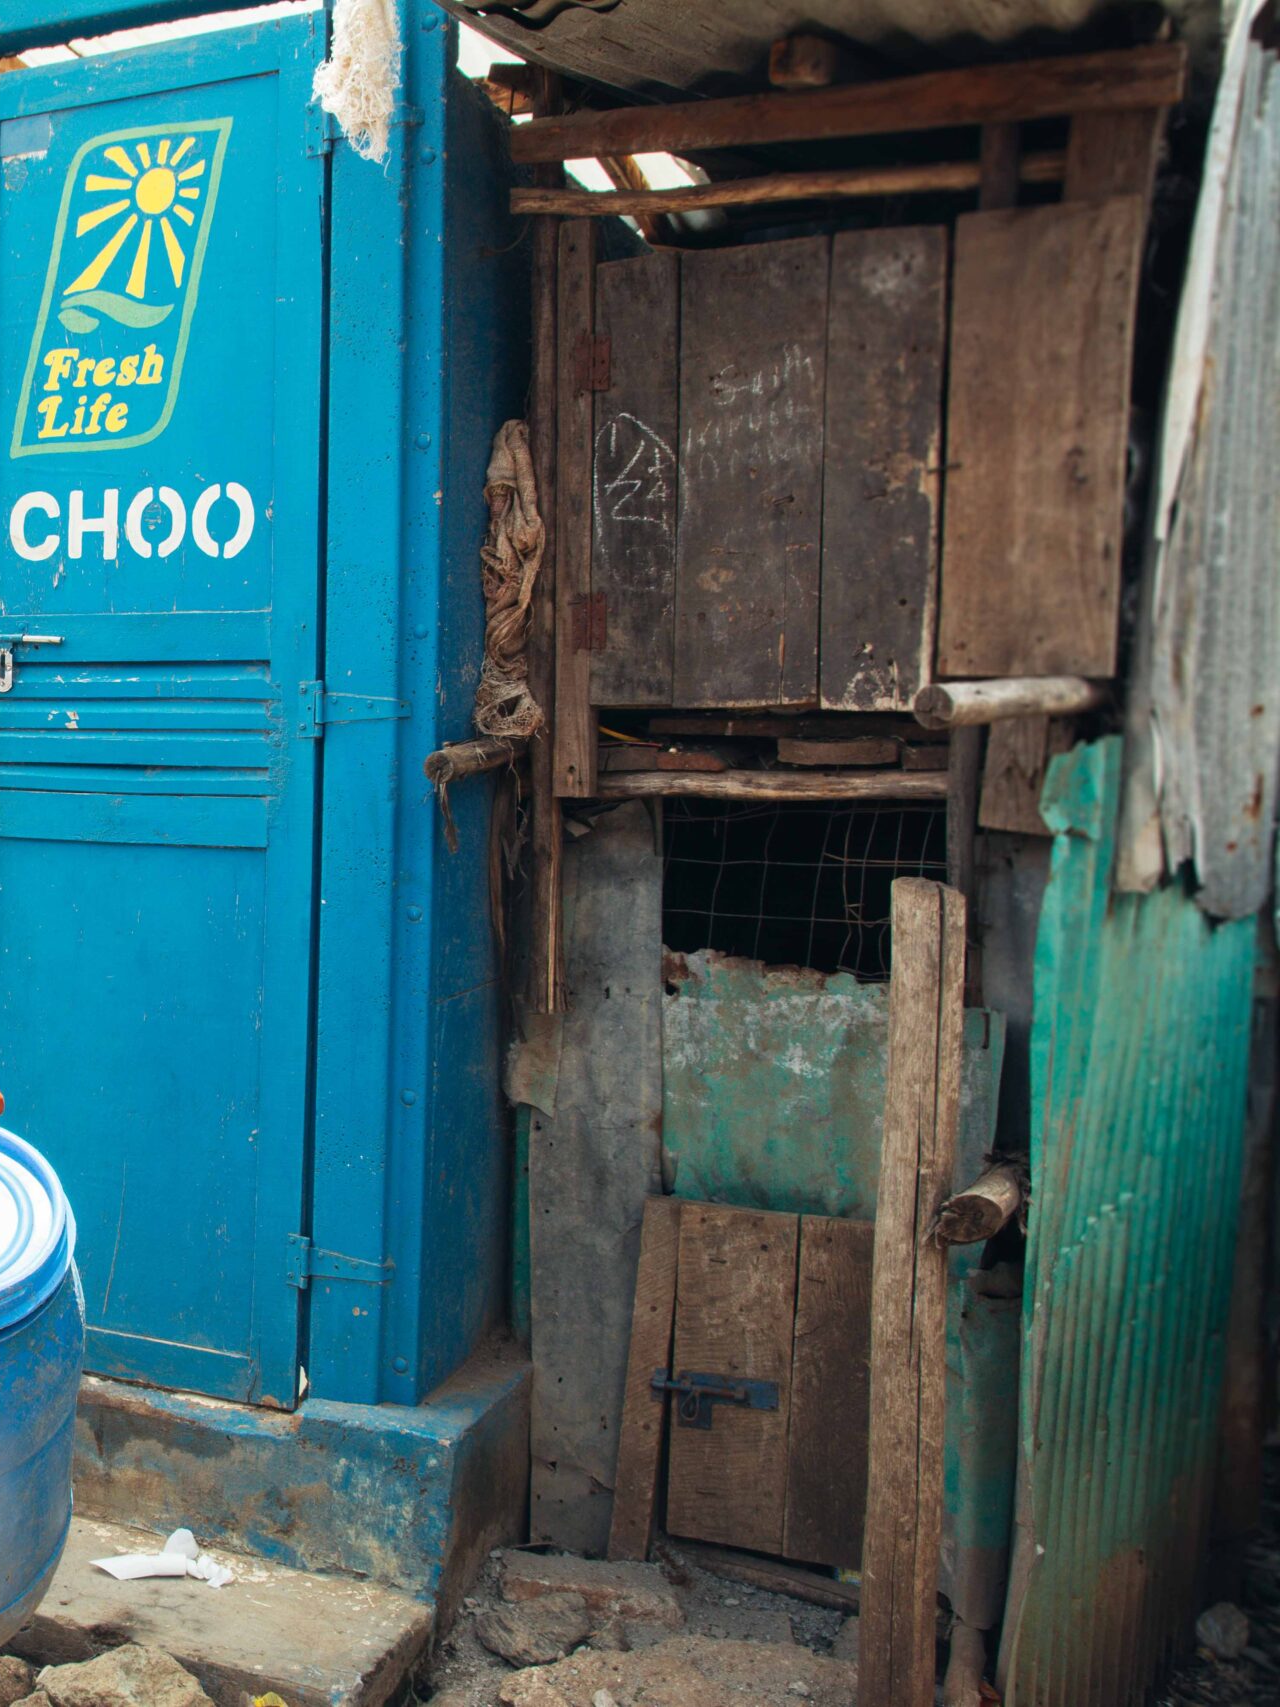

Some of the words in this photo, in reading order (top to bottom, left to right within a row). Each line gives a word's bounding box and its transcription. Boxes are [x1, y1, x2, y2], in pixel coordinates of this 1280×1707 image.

[43, 343, 164, 391] Fresh
[37, 392, 129, 439] Life
[9, 482, 255, 561] CHOO
